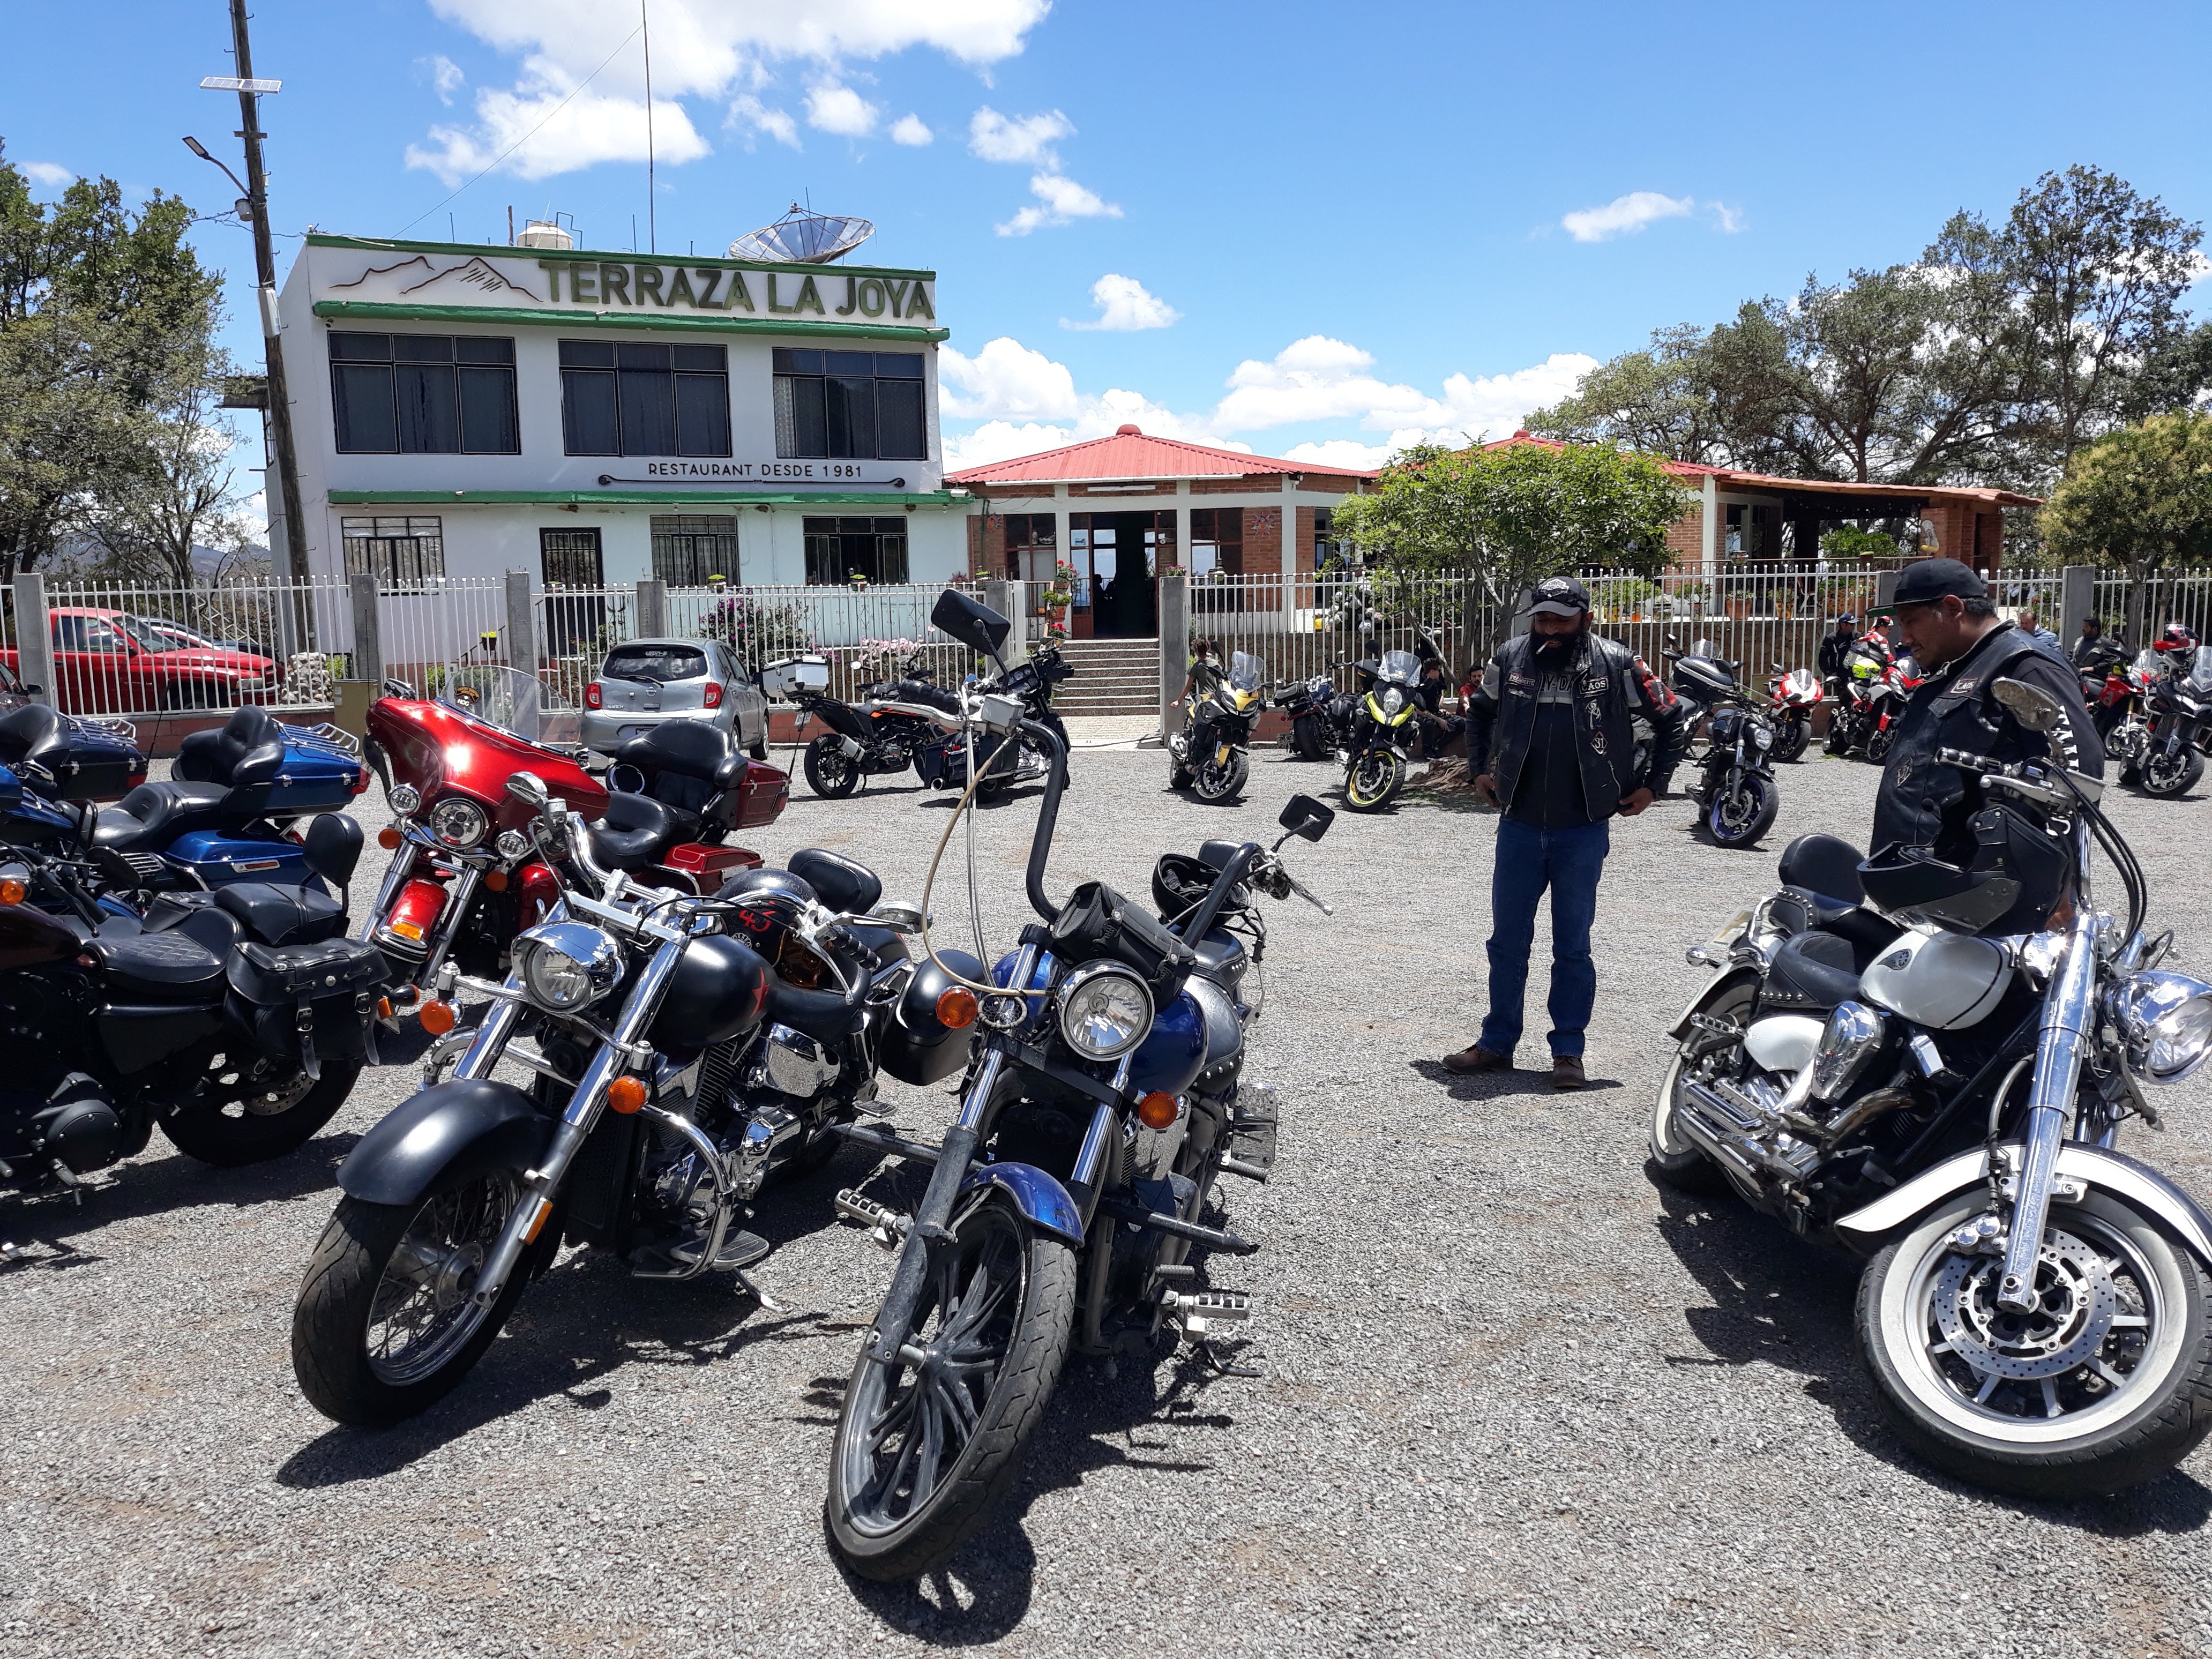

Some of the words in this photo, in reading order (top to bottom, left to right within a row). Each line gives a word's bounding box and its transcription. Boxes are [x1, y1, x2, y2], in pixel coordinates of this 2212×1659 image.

[539, 260, 755, 312] TERRAZA
[768, 273, 826, 315] LA
[835, 277, 935, 319] JOYA
[648, 463, 753, 476] RESTAURANT
[761, 464, 813, 477] DESDE
[823, 465, 862, 477] 1981
[1581, 680, 1606, 691] CAOS
[1594, 737, 1604, 749] 31
